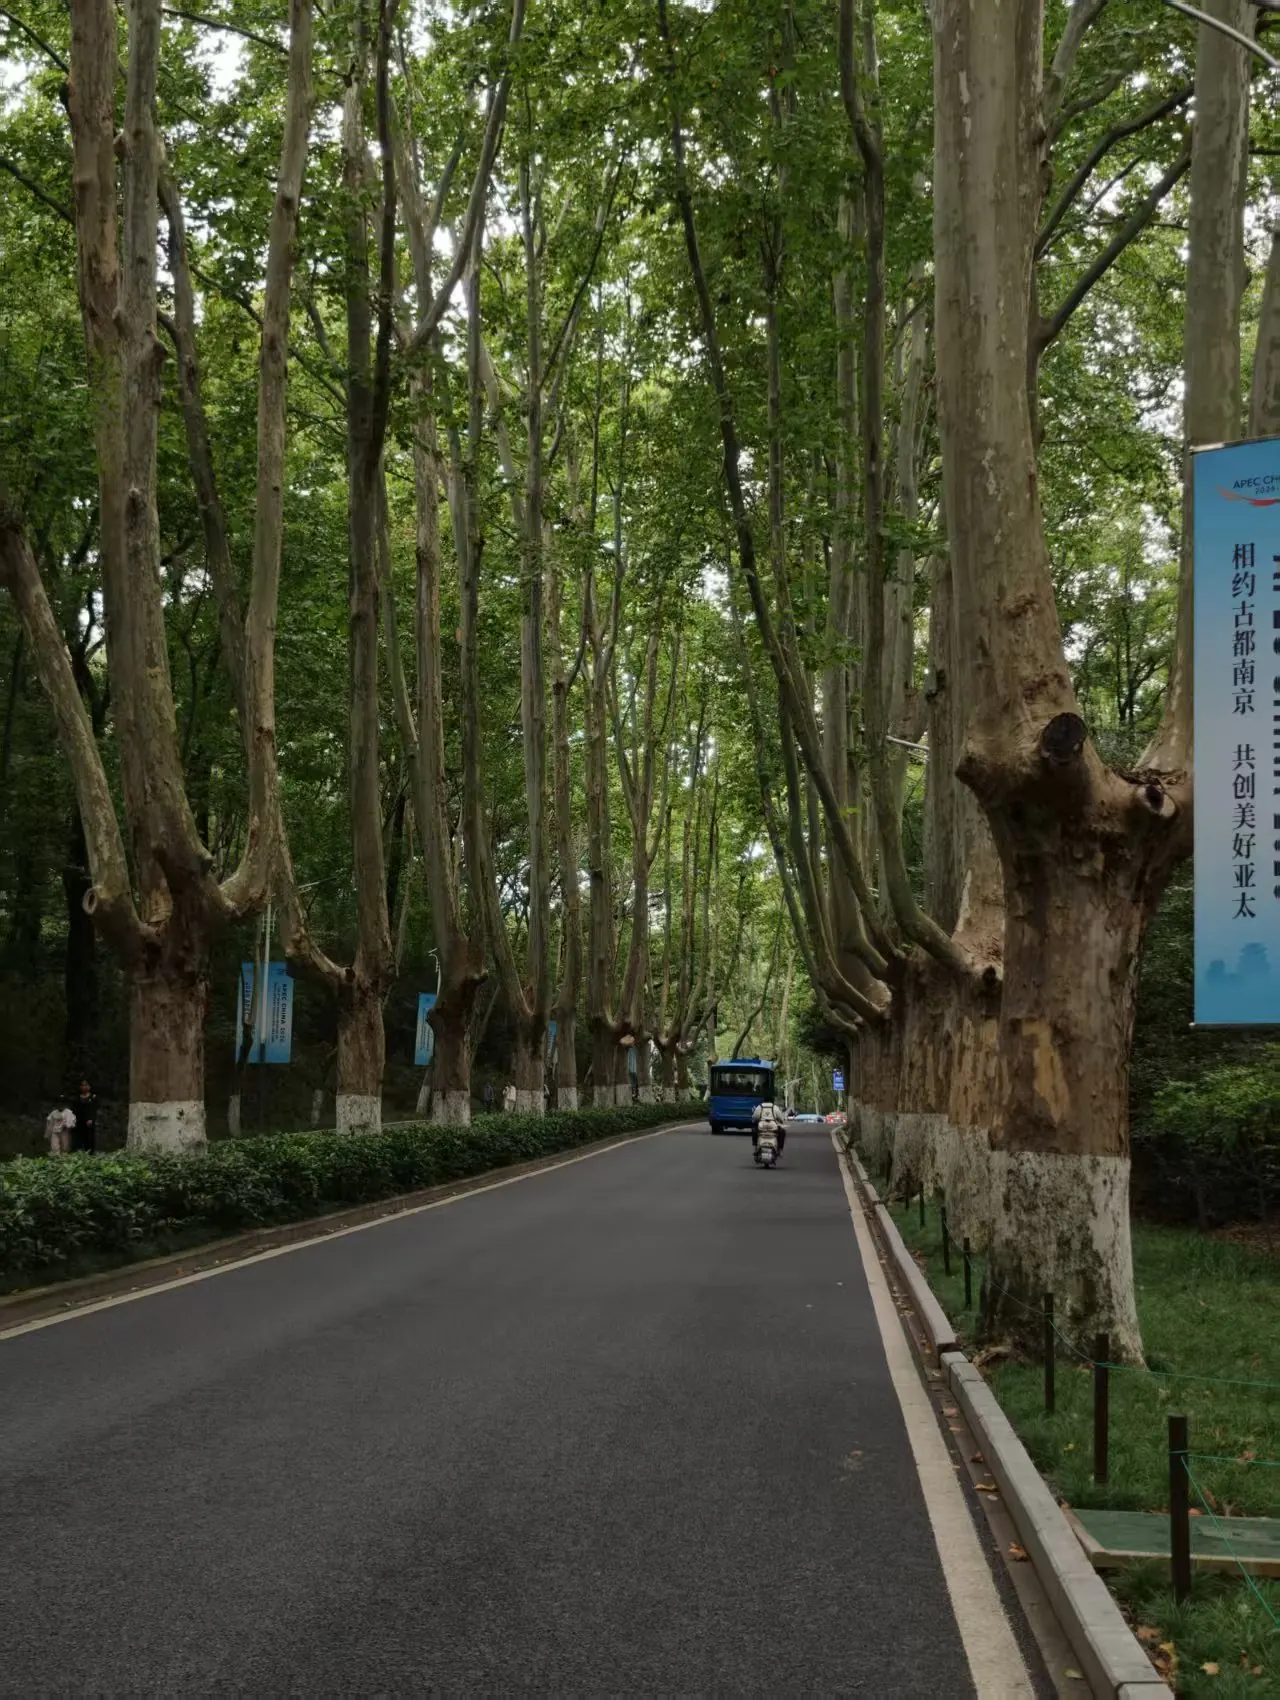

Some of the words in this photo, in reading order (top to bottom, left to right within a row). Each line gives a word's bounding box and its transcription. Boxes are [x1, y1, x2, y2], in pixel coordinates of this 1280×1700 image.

[1232, 477, 1261, 489] APEC
[1231, 542, 1256, 715] 相约古都南京
[1231, 743, 1256, 920] 共创美好亚太
